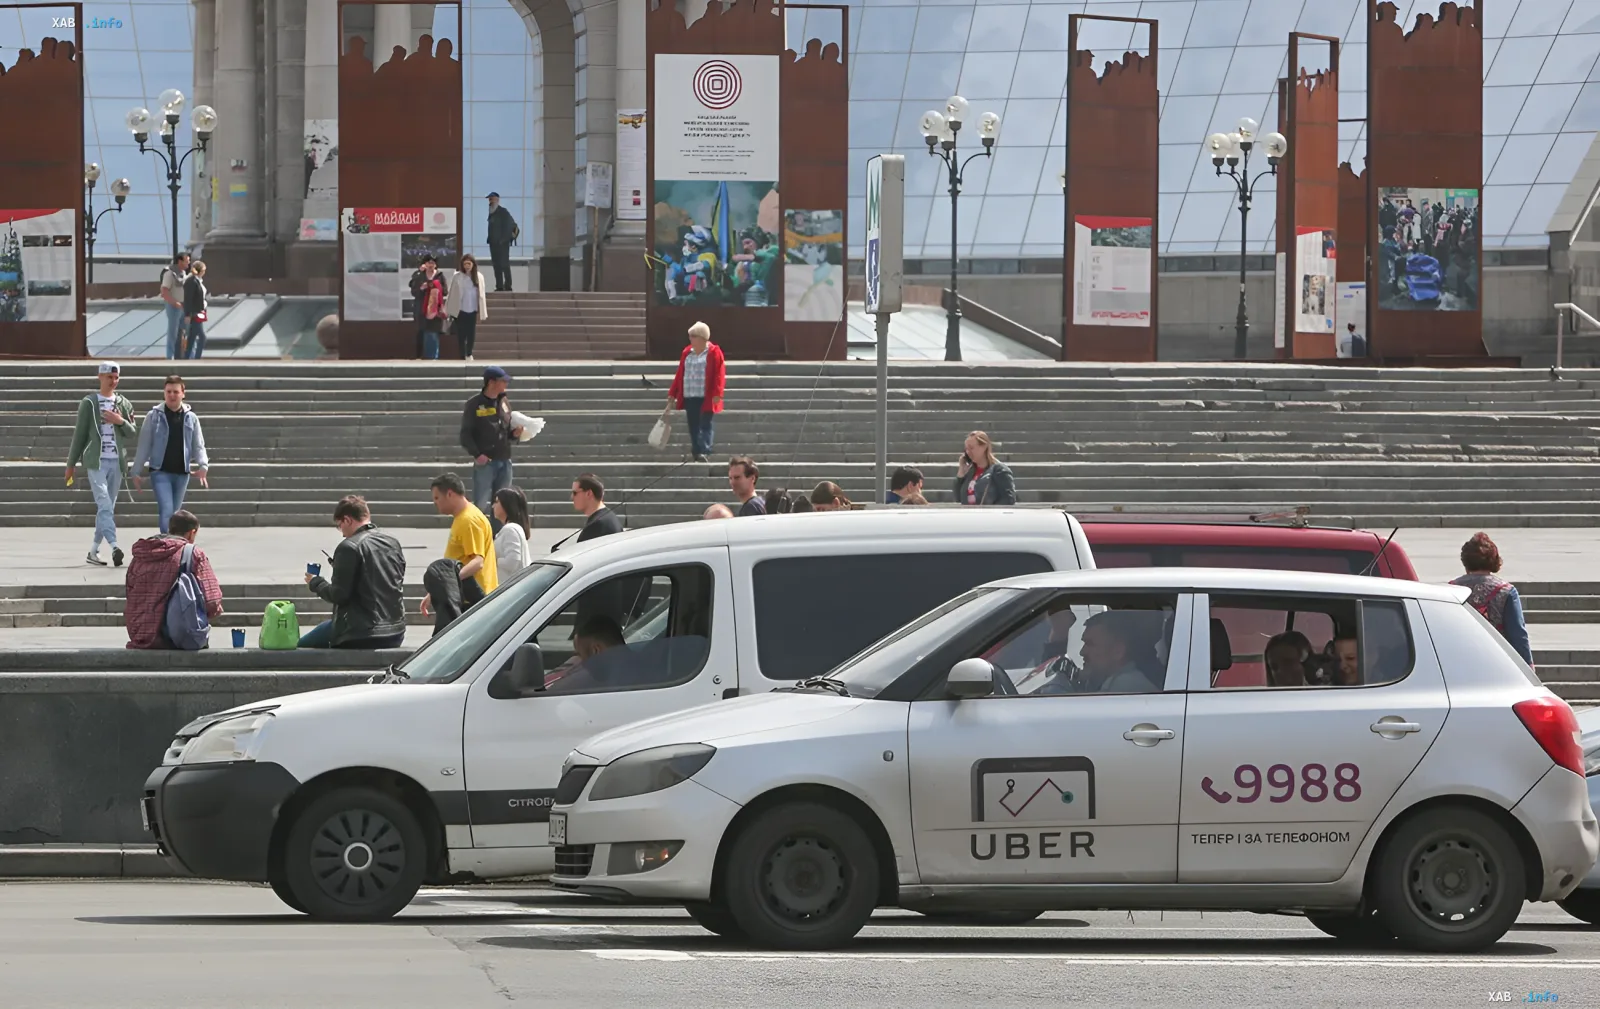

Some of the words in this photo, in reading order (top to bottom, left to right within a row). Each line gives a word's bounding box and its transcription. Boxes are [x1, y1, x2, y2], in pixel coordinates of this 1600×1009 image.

[1233, 763, 1362, 804] 9988
[970, 831, 1096, 860] UBER
[1191, 833, 1234, 844] ТЕПЕР
[1244, 833, 1263, 843] ЗА
[1265, 832, 1350, 843] ТЕЛЕФОНОМ
